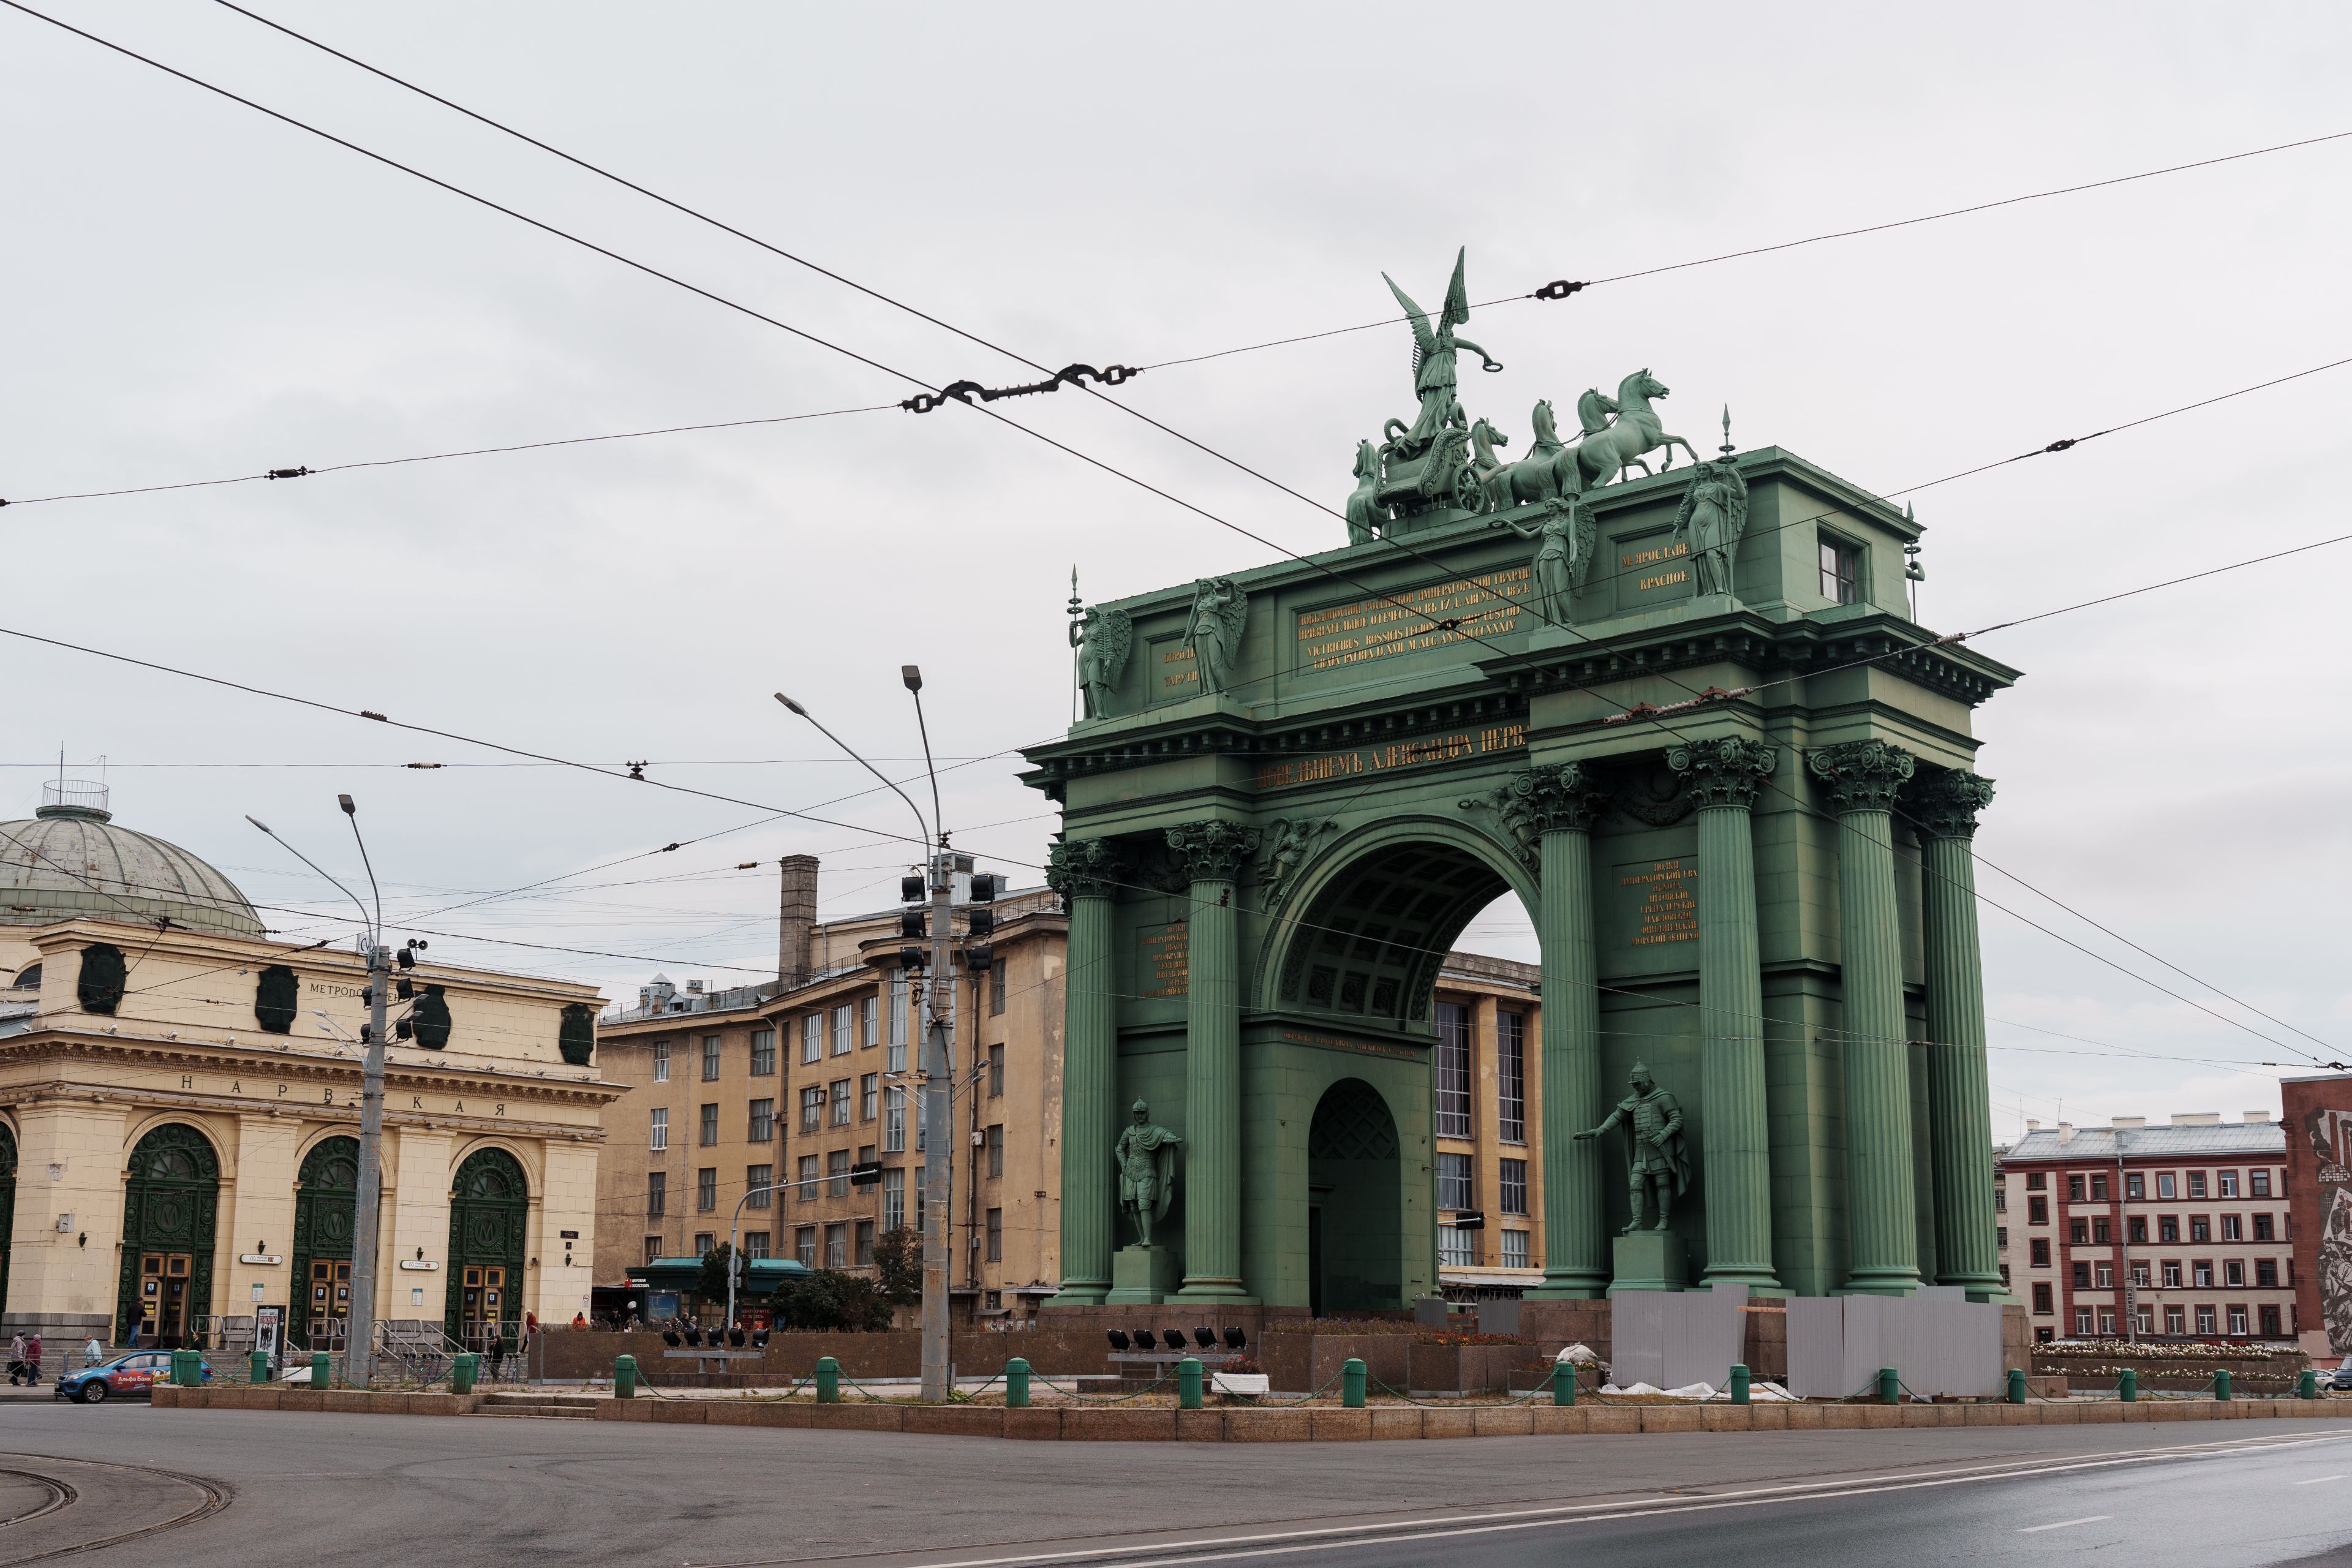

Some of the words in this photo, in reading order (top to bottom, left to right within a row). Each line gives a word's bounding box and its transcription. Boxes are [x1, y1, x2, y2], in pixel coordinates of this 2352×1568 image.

[1418, 574, 1491, 601] ИМПЕРАТОРСКОЙ
[1640, 570, 1690, 590] КРАСНОЕ.
[1298, 617, 1367, 641] ПРИЗНАТЕЛЬНОЕ
[1371, 605, 1422, 626] ОТЕЧЕСТВО
[1425, 603, 1437, 614] ВЪ
[1441, 598, 1451, 611] 17
[1463, 588, 1503, 605] АВГУСТА
[1308, 637, 1360, 657] VICTRICIBUS
[1366, 628, 1403, 646] ROSSICIS
[1314, 655, 1341, 669] GRATA
[1370, 734, 1473, 771] АЛЕКСАНДРА
[1654, 861, 1679, 871] ПОЛКИ
[310, 983, 399, 1001] МЕТРОПОЕН
[181, 1075, 505, 1117] НАРВКАЯ
